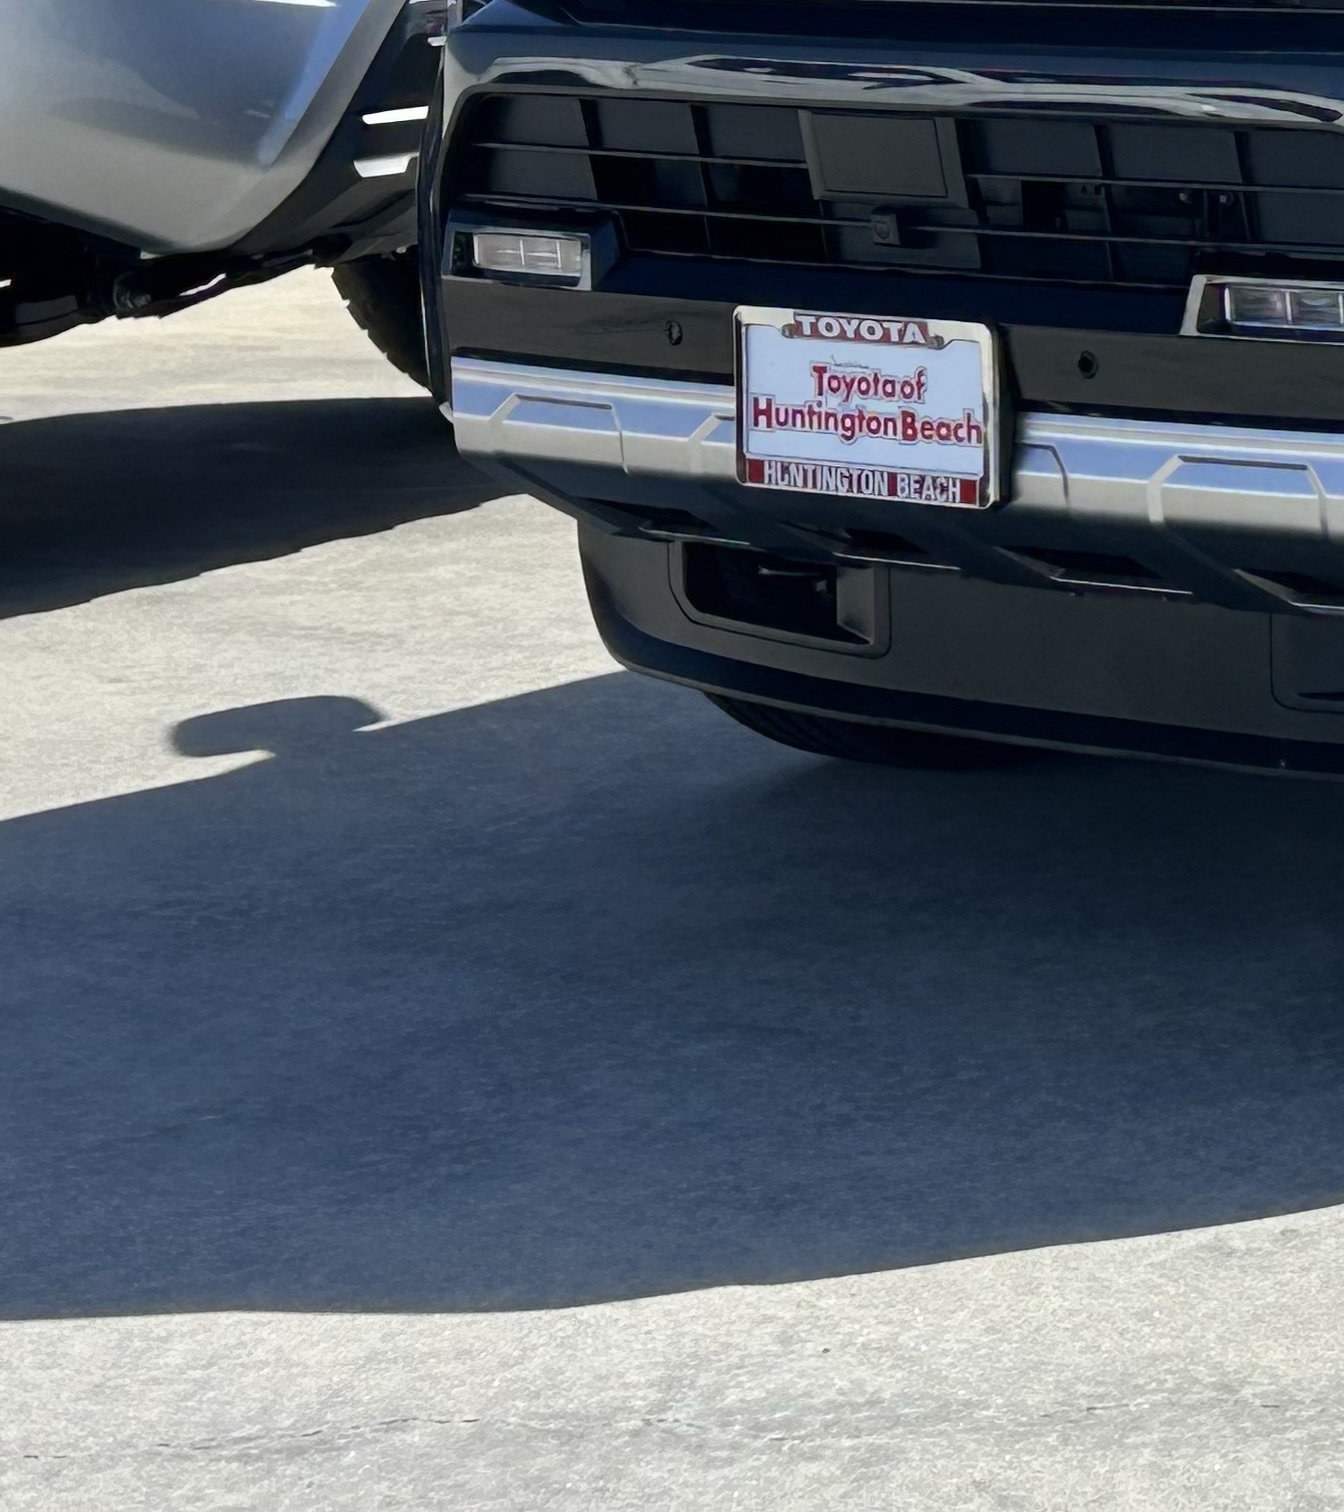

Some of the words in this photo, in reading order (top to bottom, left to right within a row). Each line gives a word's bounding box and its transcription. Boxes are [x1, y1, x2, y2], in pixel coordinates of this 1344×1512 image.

[795, 314, 926, 344] TOYOTA
[811, 364, 896, 404] Toyota
[900, 366, 927, 402] of
[752, 396, 898, 442] Huntington
[900, 409, 982, 445] Beach
[763, 460, 888, 497] HUNTINGTON
[896, 473, 962, 504] BEACH
